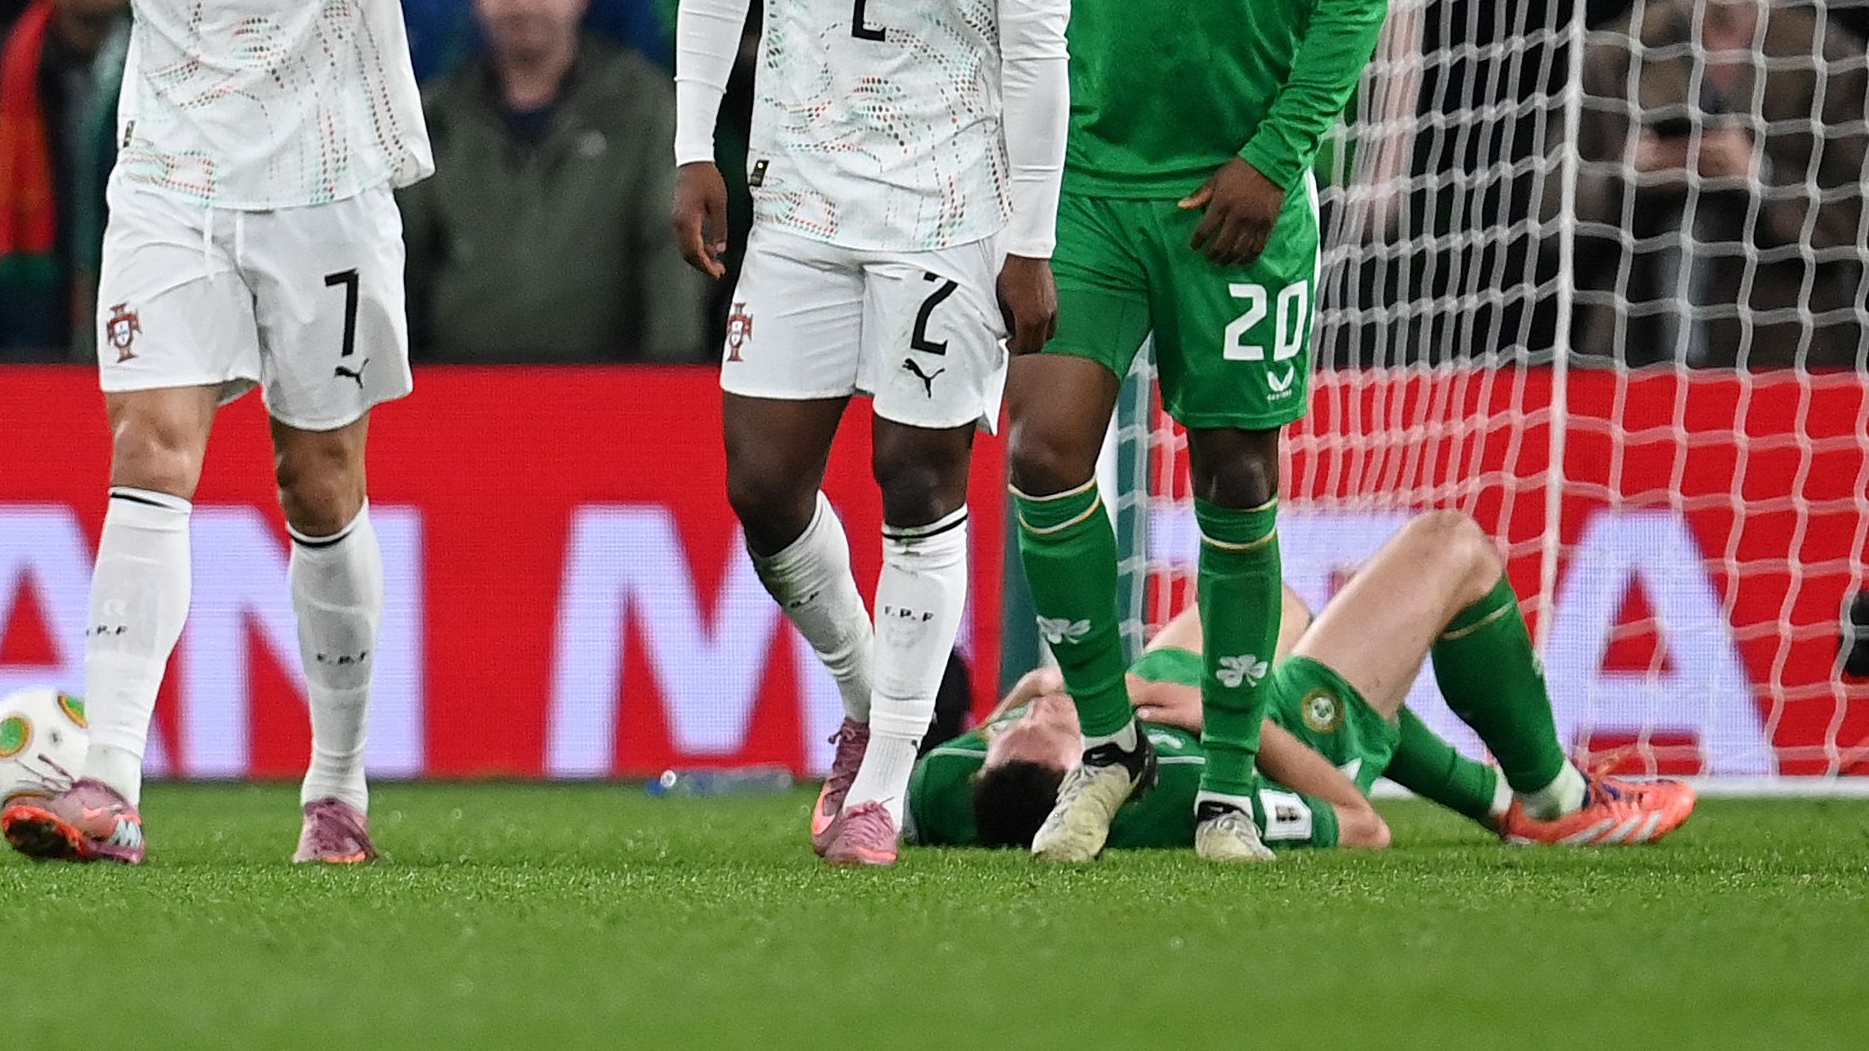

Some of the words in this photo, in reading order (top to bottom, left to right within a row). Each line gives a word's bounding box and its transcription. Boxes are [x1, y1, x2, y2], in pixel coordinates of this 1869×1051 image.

[324, 268, 360, 358] 7
[910, 271, 959, 357] 2
[1223, 279, 1308, 362] 20
